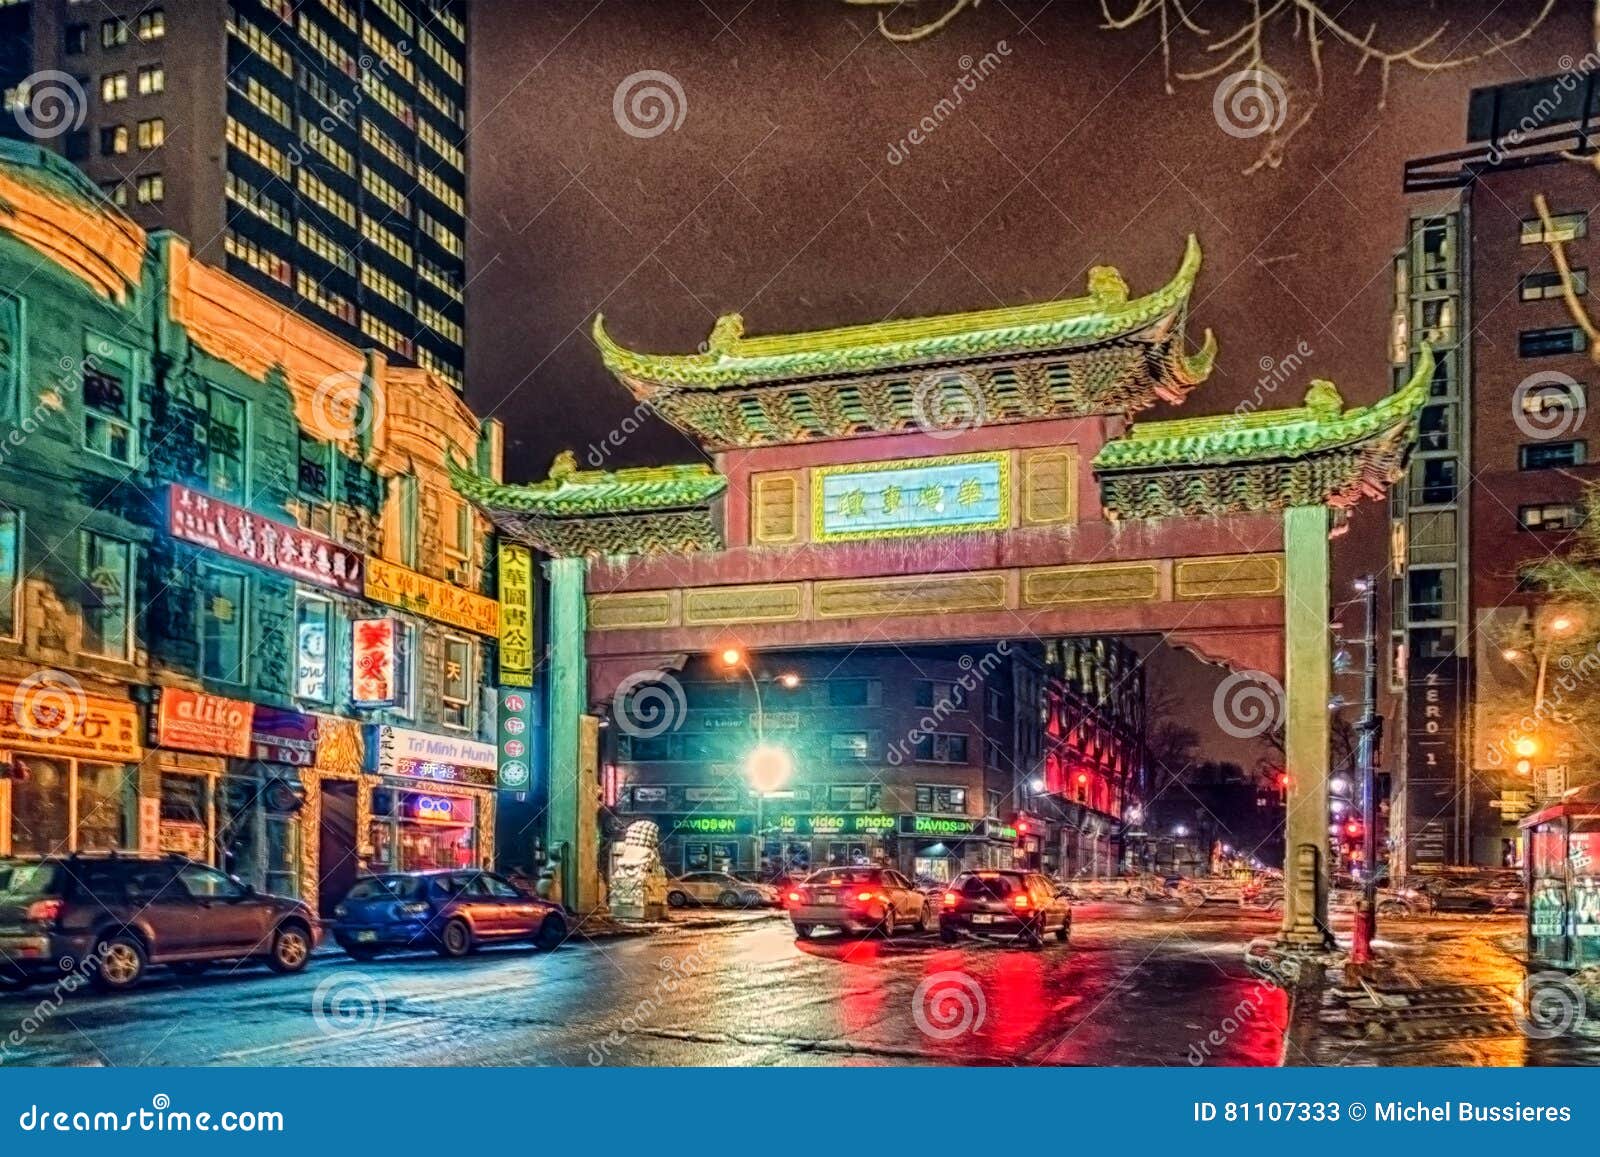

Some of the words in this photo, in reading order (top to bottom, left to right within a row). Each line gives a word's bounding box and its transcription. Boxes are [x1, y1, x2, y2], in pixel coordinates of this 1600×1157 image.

[427, 740, 458, 757] Minh
[673, 818, 736, 832] DAVIDSON
[856, 815, 895, 829] photo
[915, 817, 974, 832] DAVIDSON
